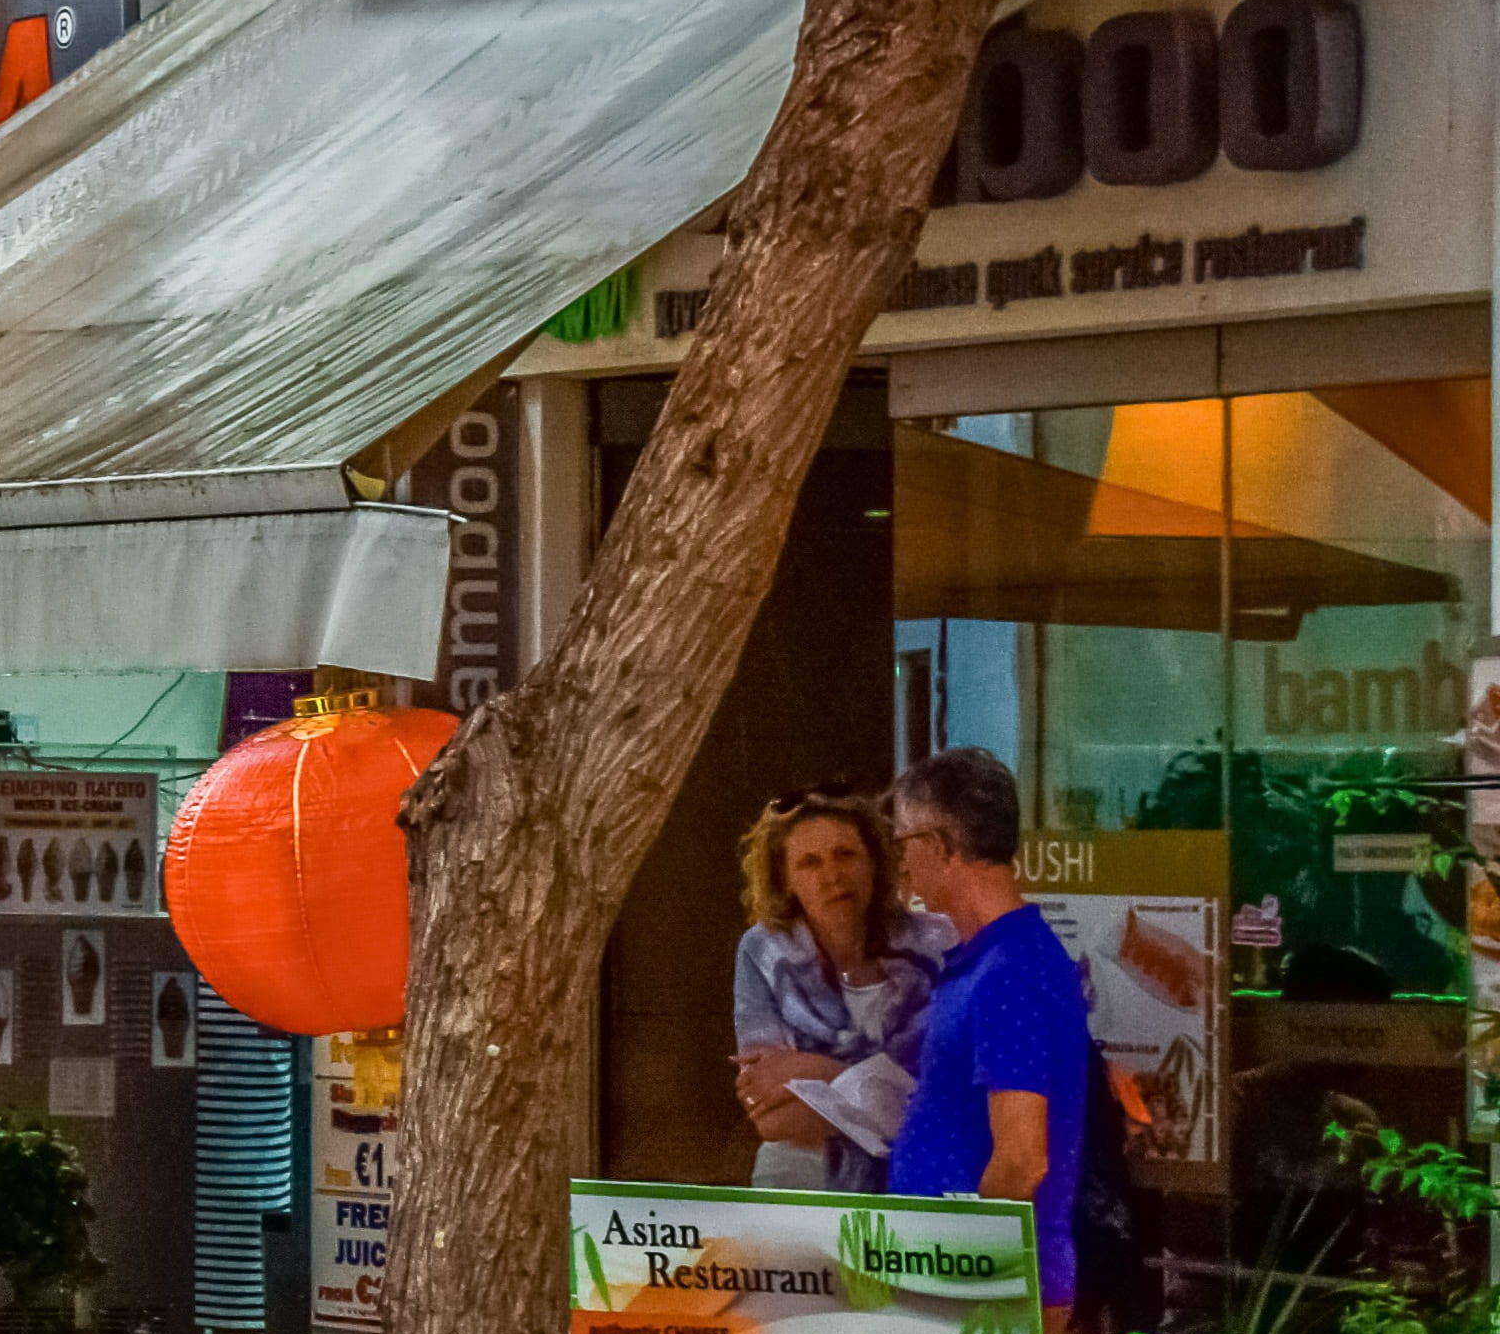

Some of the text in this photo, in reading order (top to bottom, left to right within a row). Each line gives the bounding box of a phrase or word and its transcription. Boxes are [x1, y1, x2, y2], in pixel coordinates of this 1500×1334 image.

[1194, 216, 1366, 284] restaurant
[450, 411, 499, 712] amboo
[1264, 639, 1467, 734] bamb
[85, 781, 146, 798] ΠΑΓΩΤΟ
[354, 1142, 394, 1188] €1.
[602, 1209, 704, 1250] Asian
[335, 1239, 386, 1267] JUIC
[644, 1251, 835, 1296] Restaurant
[864, 1240, 995, 1279] bamboo
